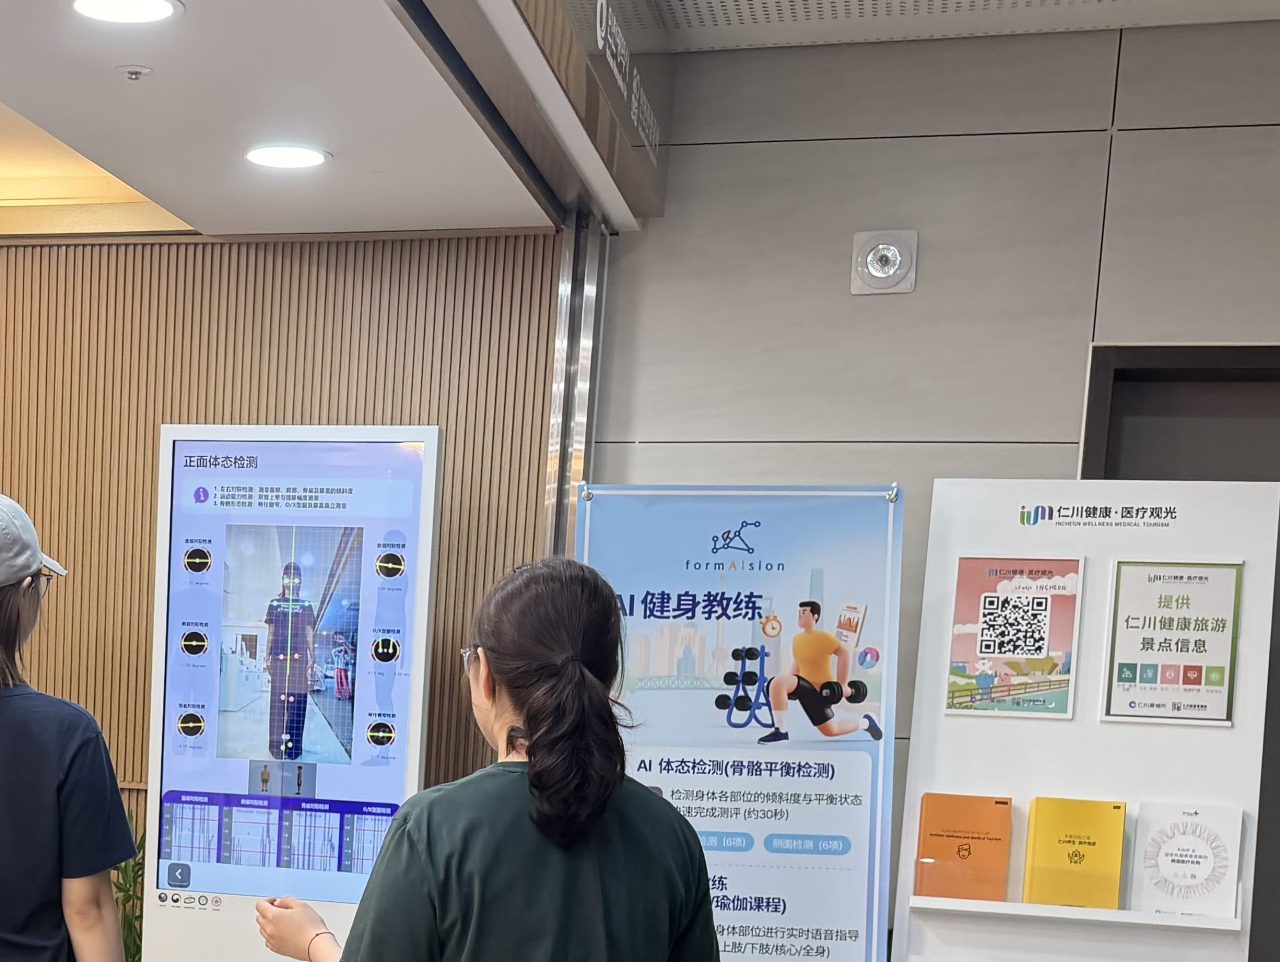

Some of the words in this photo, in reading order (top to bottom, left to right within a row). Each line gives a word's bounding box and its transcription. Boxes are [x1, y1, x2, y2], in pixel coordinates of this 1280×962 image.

[183, 455, 258, 469] 正面体态检测
[685, 560, 785, 572] formAIsion
[641, 590, 763, 620] 健身教练
[1157, 594, 1191, 609] 提供
[1124, 615, 1228, 633] 仁川健康旅游
[1140, 637, 1207, 653] 景点信息
[637, 759, 652, 772] AI
[658, 757, 835, 781] 体态检测(骨骼平衡检测)
[670, 788, 863, 807] 检测身体各部位的倾斜度与平衡状态
[716, 924, 860, 941] 身体部位进行实时语音指导
